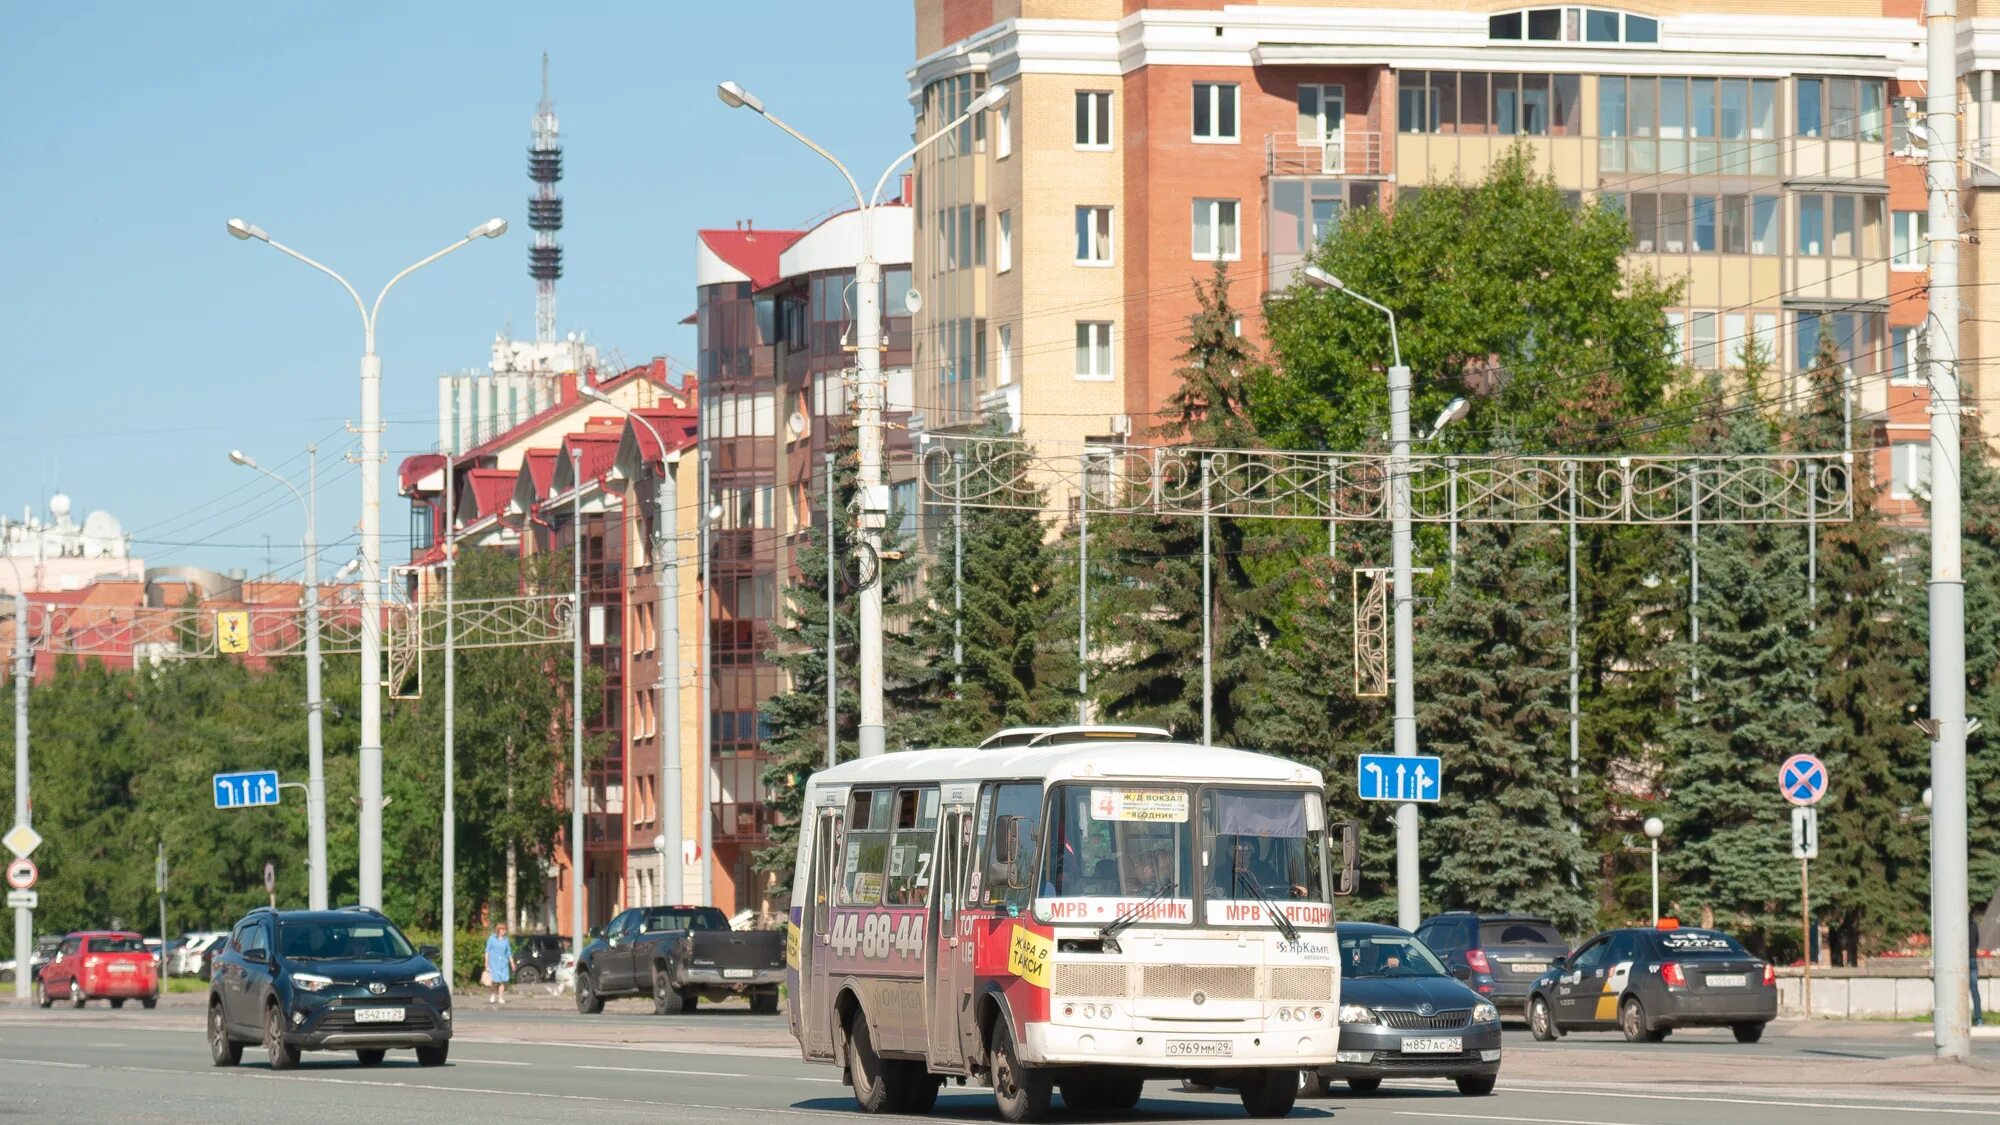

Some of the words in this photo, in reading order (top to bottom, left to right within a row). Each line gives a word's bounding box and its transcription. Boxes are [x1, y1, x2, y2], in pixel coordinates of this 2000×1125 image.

[1099, 796, 1115, 815] 4
[1050, 902, 1088, 918] МРВ
[1116, 903, 1187, 920] ЯГОДНИК
[1225, 905, 1261, 921] МРВ
[830, 913, 924, 959] 44-88-44
[1038, 948, 1048, 960] В
[1013, 950, 1043, 976] ТАКСИ
[1170, 1042, 1215, 1054] О969ММ
[1217, 1042, 1229, 1051] 29
[1406, 1039, 1446, 1050] М857АС
